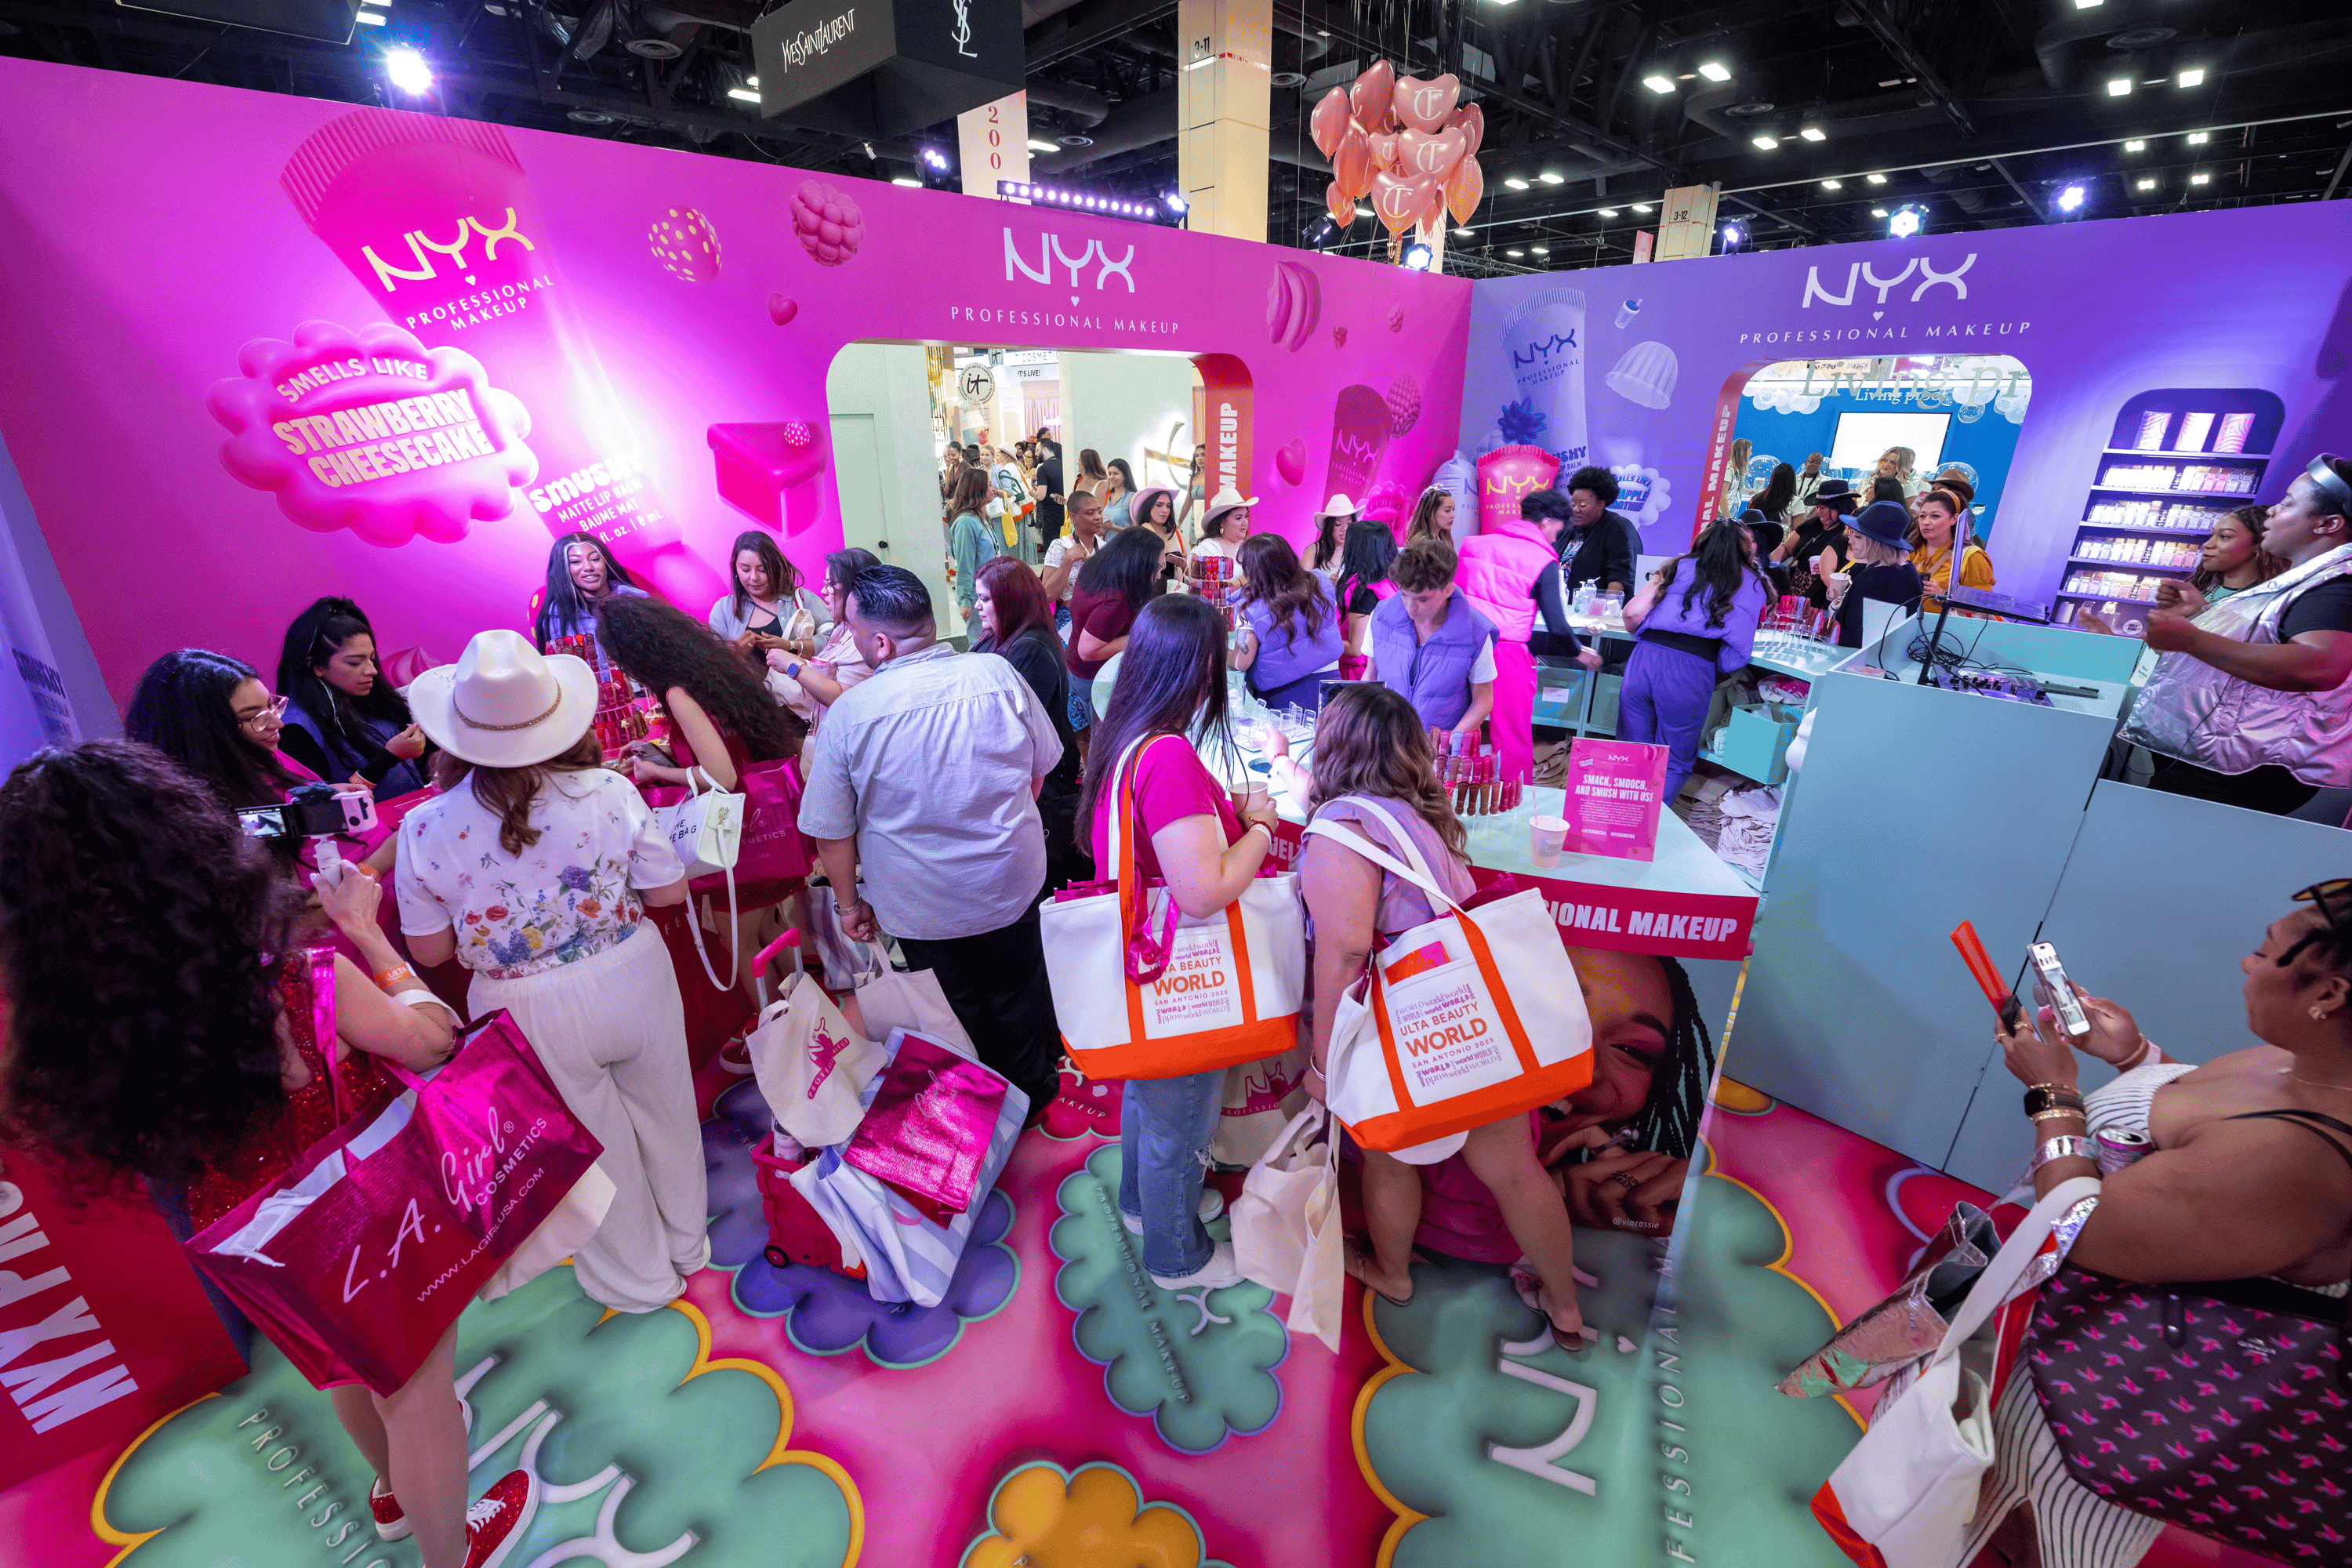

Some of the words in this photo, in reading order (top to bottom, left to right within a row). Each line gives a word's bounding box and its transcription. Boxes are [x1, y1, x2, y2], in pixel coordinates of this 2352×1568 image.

[1673, 210, 1689, 221] 3-12
[361, 207, 535, 292] NYX
[1003, 227, 1135, 293] NYX
[1802, 252, 1978, 308] NYX
[405, 274, 554, 329] PROFESSIONAL
[450, 296, 528, 331] MAKEUP
[950, 306, 1102, 330] PROFESSIONAL
[1113, 318, 1178, 334] MAKEUP
[1740, 326, 1908, 344] PROFESSIONAL
[1925, 321, 2031, 338] MAKEUP
[1513, 328, 1577, 369] NYX
[276, 358, 367, 403] SMELLS
[371, 357, 428, 381] LIKE
[967, 372, 989, 395] it
[1798, 360, 1955, 410] Living
[273, 388, 477, 456] STRAWBERRY
[308, 423, 496, 488] CHEESECAKE
[1335, 429, 1380, 469] NYX
[1708, 404, 1731, 492] MAKEUP
[557, 498, 596, 524] MATTE
[593, 490, 612, 506] LIP
[612, 477, 644, 499] BALM
[579, 506, 618, 532] BAUME
[615, 496, 640, 516] MAT
[614, 525, 631, 538] oz.
[636, 514, 646, 527] 8
[1575, 785, 1591, 796] AND
[1591, 786, 1618, 799] SMUSH
[1618, 789, 1639, 801] WITH
[1639, 791, 1653, 803] US!
[1582, 774, 1612, 787] SMACK,
[1613, 777, 1648, 791] SMOOCH,
[678, 825, 697, 840] BAG
[1628, 910, 1738, 942] MAKEUP
[1179, 956, 1221, 971] BEAUTY
[1152, 971, 1225, 996] WORLD
[1172, 993, 1208, 1003] ANTONIO
[1442, 994, 1470, 1008] WORLD
[1400, 1019, 1430, 1036] ULTA
[1431, 1000, 1479, 1026] BEAUTY
[1405, 1018, 1488, 1058] WORLD
[1412, 1059, 1429, 1069] SAN
[1432, 1045, 1472, 1062] ANTONIO
[1474, 1037, 1494, 1049] 2025
[1058, 1096, 1105, 1118] AKEUP
[475, 1117, 547, 1207] COSMETICS
[1612, 1216, 1660, 1229] @viacassie
[343, 1197, 441, 1304] L.A.
[1095, 1185, 1154, 1312] PROFESSIONAL
[1148, 1320, 1191, 1403] MAKEUP
[1653, 1303, 1697, 1564] FESSIONAL
